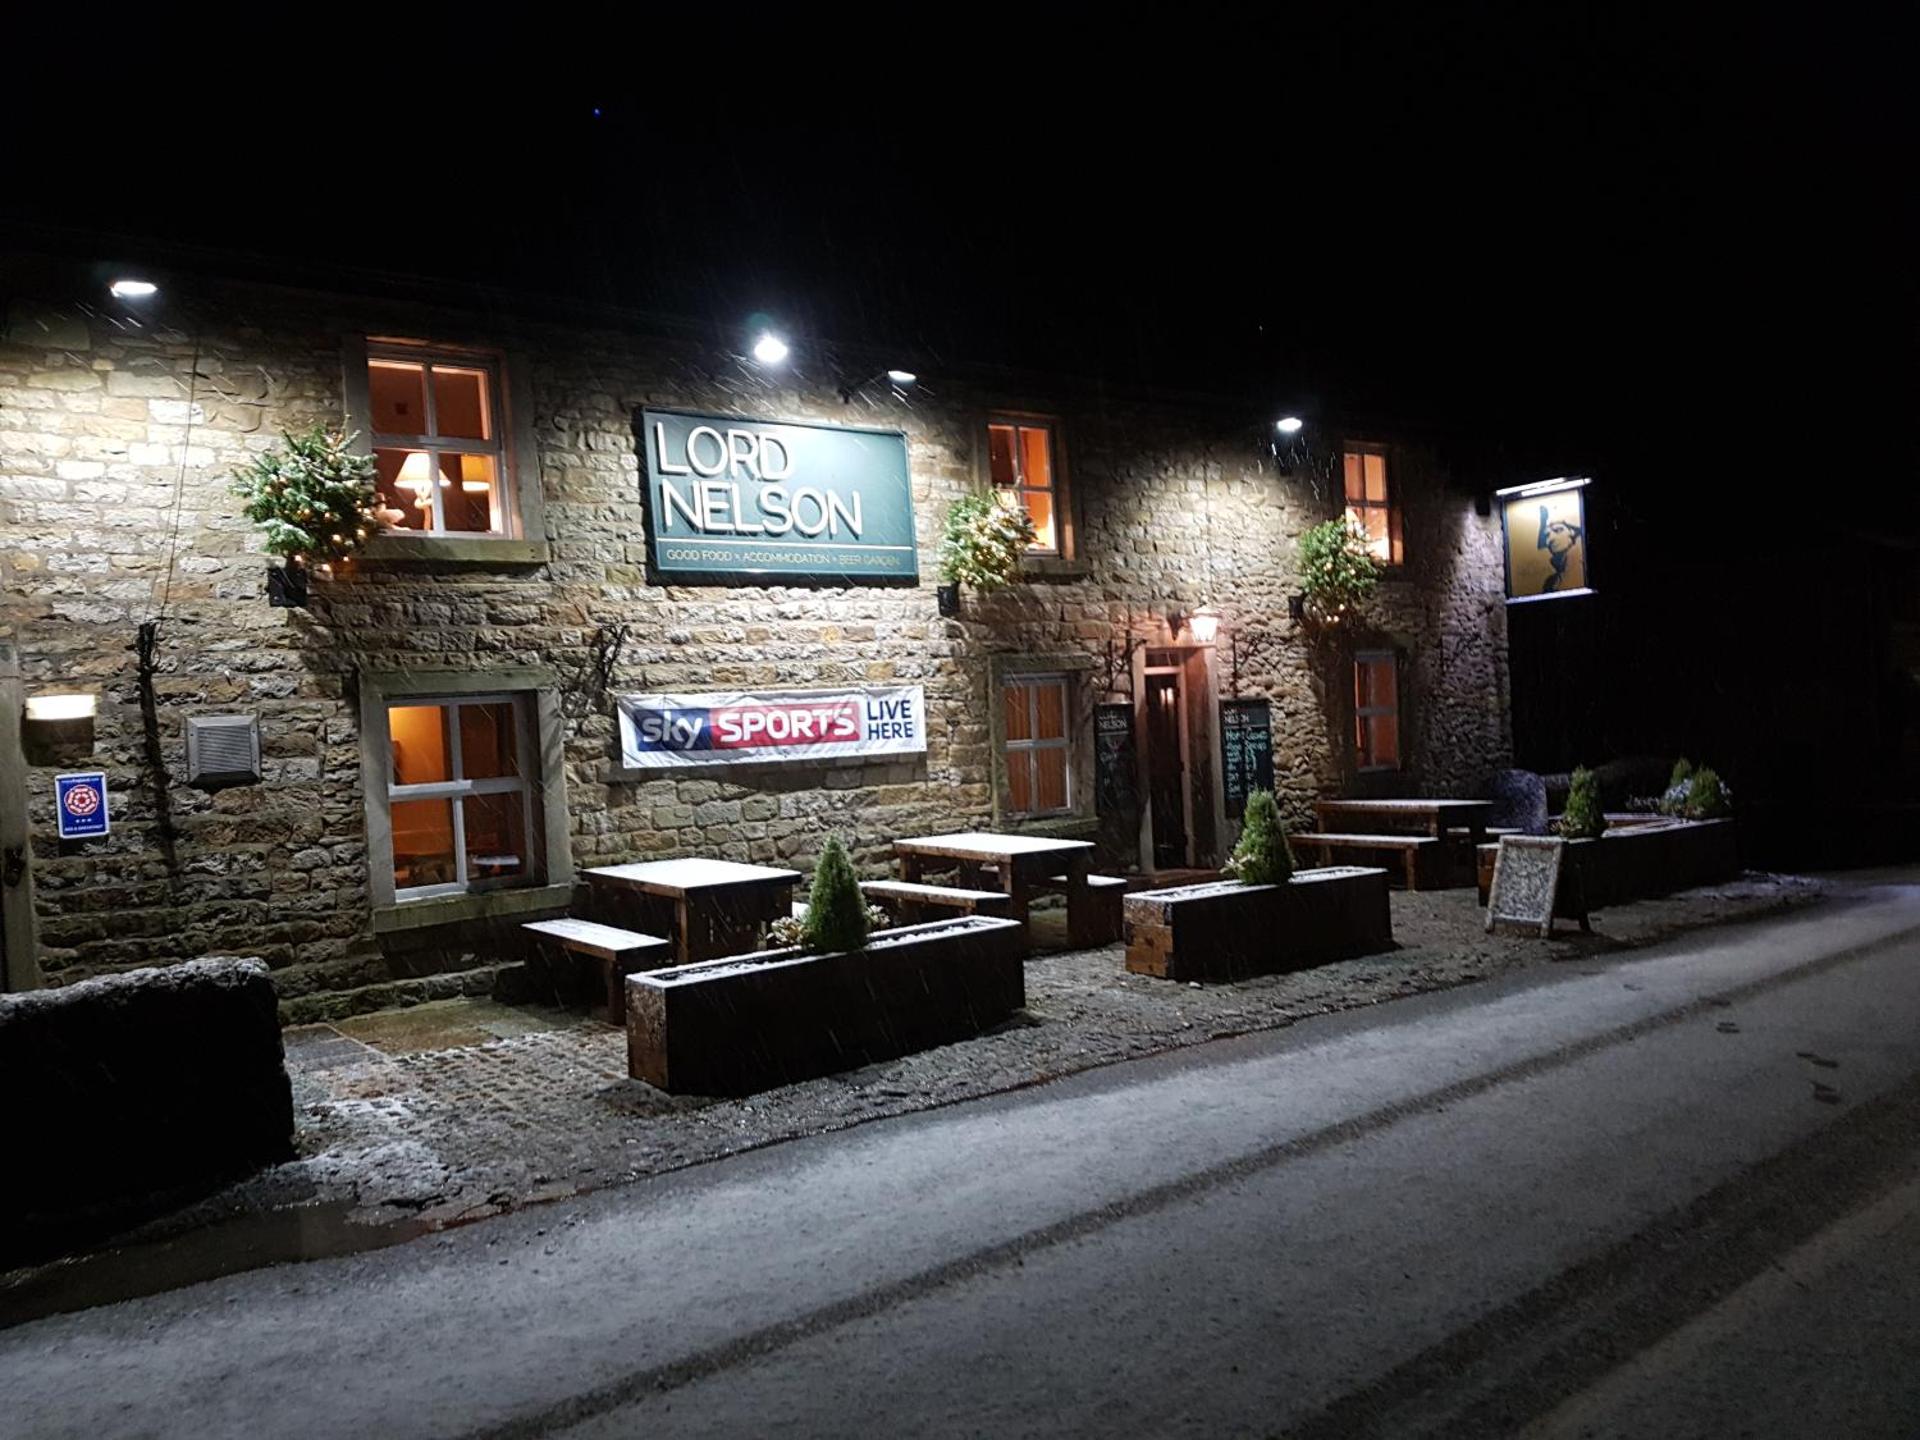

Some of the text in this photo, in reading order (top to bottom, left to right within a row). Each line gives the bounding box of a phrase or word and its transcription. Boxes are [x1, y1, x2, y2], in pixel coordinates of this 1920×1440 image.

[657, 422, 793, 481] LORD
[661, 479, 864, 537] NELSON
[666, 549, 700, 560] GOOD
[702, 551, 732, 561] FOOD
[867, 699, 912, 720] LIVE
[642, 706, 855, 749] sky SPORTS
[868, 721, 913, 740] HERE
